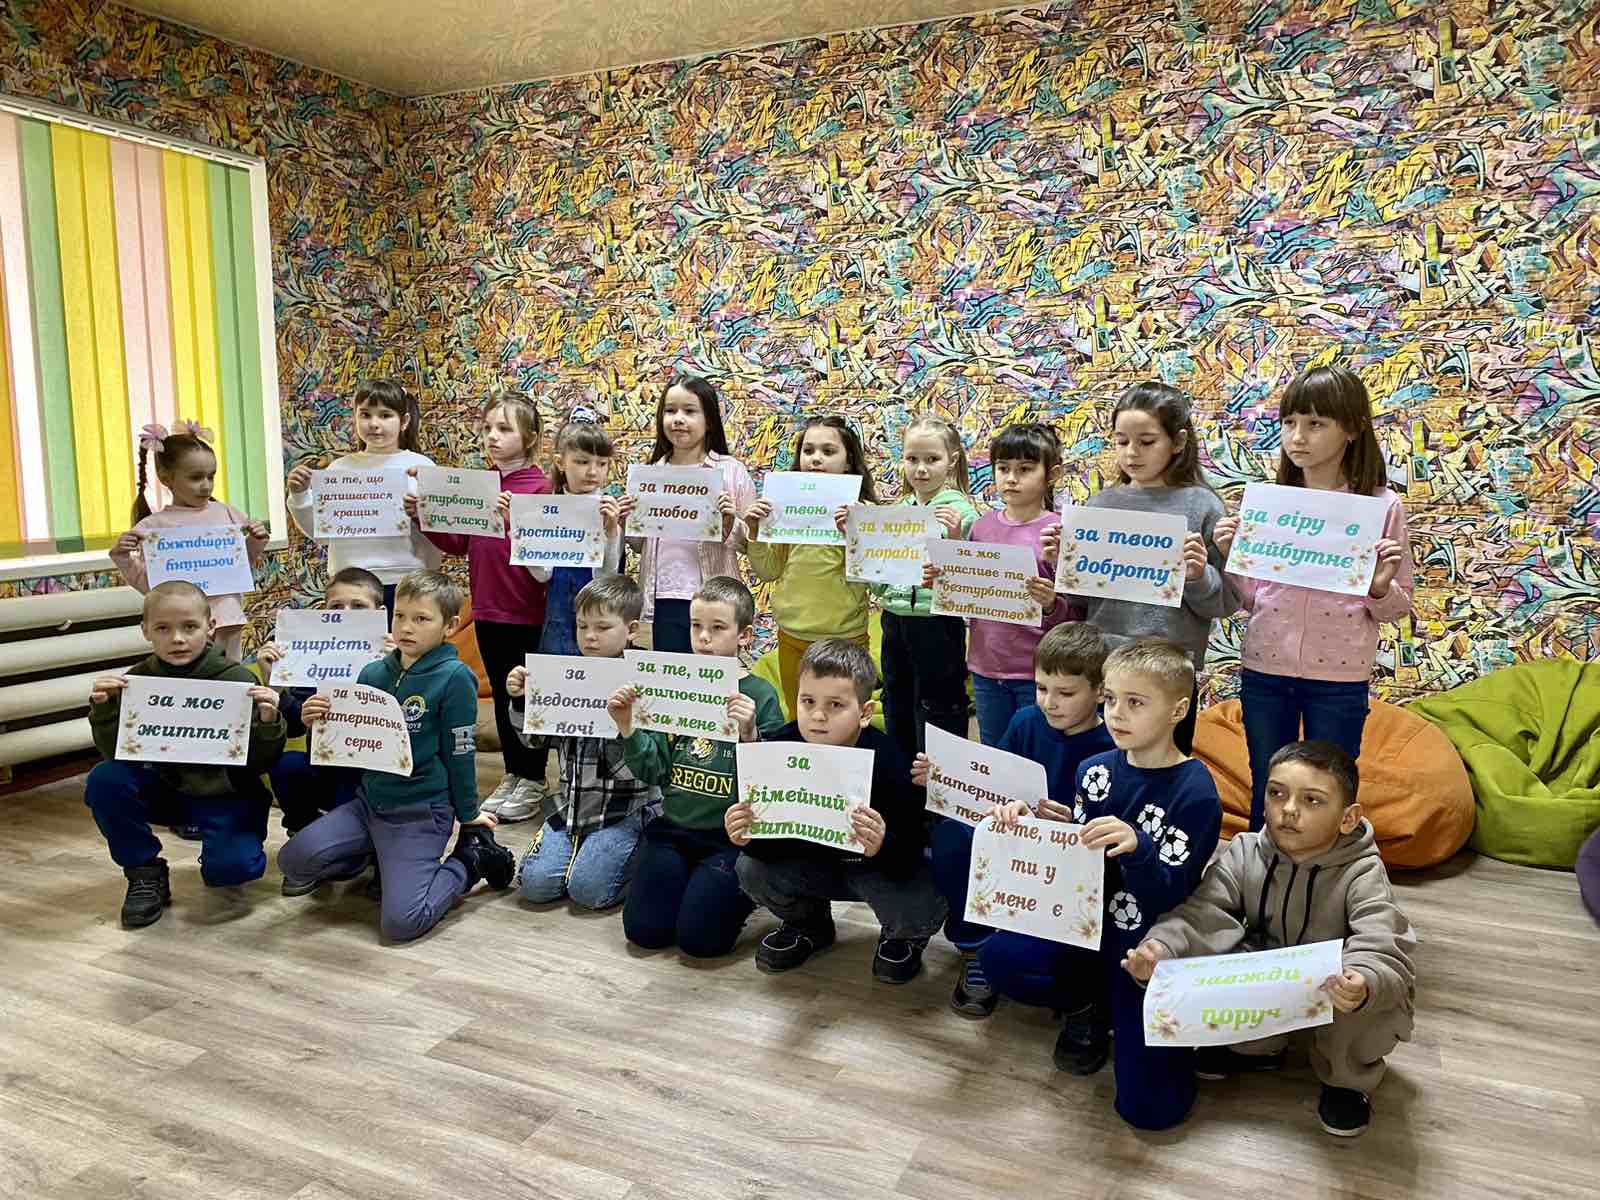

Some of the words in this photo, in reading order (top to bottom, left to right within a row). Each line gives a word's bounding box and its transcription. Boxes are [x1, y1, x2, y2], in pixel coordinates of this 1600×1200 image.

[324, 475, 337, 484] за
[342, 475, 362, 485] те,
[367, 475, 384, 485] що
[447, 474, 461, 484] за
[639, 482, 657, 493] за
[663, 483, 709, 496] твою
[428, 493, 484, 509] турботу
[543, 504, 560, 515] за
[785, 503, 828, 515] твою
[334, 508, 379, 520] кращим
[647, 504, 699, 520] любов
[336, 524, 377, 536] другом
[858, 520, 877, 533] за
[881, 519, 928, 537] мудрі
[1242, 508, 1269, 523] за
[1276, 510, 1327, 537] віру
[1345, 522, 1361, 537] в
[518, 525, 586, 543] постійну
[1074, 528, 1100, 542] за
[1108, 530, 1174, 549] твою
[518, 546, 585, 565] допомогу
[864, 544, 921, 561] поради
[957, 547, 972, 557] за
[976, 549, 1001, 560] моє
[943, 564, 1000, 577] щасливе
[1004, 569, 1025, 581] та
[1075, 555, 1171, 587] доброту
[943, 580, 1033, 601] безтурботне
[320, 612, 343, 624] за
[291, 636, 372, 655] щирість
[306, 663, 353, 681] душі
[565, 668, 586, 681] за
[636, 661, 657, 673] за
[663, 663, 691, 680] те,
[699, 667, 725, 683] що
[147, 694, 175, 708] за
[182, 696, 226, 710] моє
[332, 688, 349, 700] за
[532, 692, 609, 710] недоспа
[555, 720, 595, 735] ночі
[652, 712, 672, 725] за
[675, 715, 718, 732] мене
[136, 723, 231, 740] життя
[344, 734, 384, 753] серце
[786, 755, 811, 770] за
[970, 761, 991, 776] за
[671, 767, 734, 795] REGON
[955, 804, 986, 823] те
[987, 820, 1008, 834] за
[1049, 829, 1079, 851] що
[1010, 858, 1038, 875] ти
[1044, 865, 1058, 885] у
[992, 891, 1037, 911] мене
[1052, 903, 1063, 918] є
